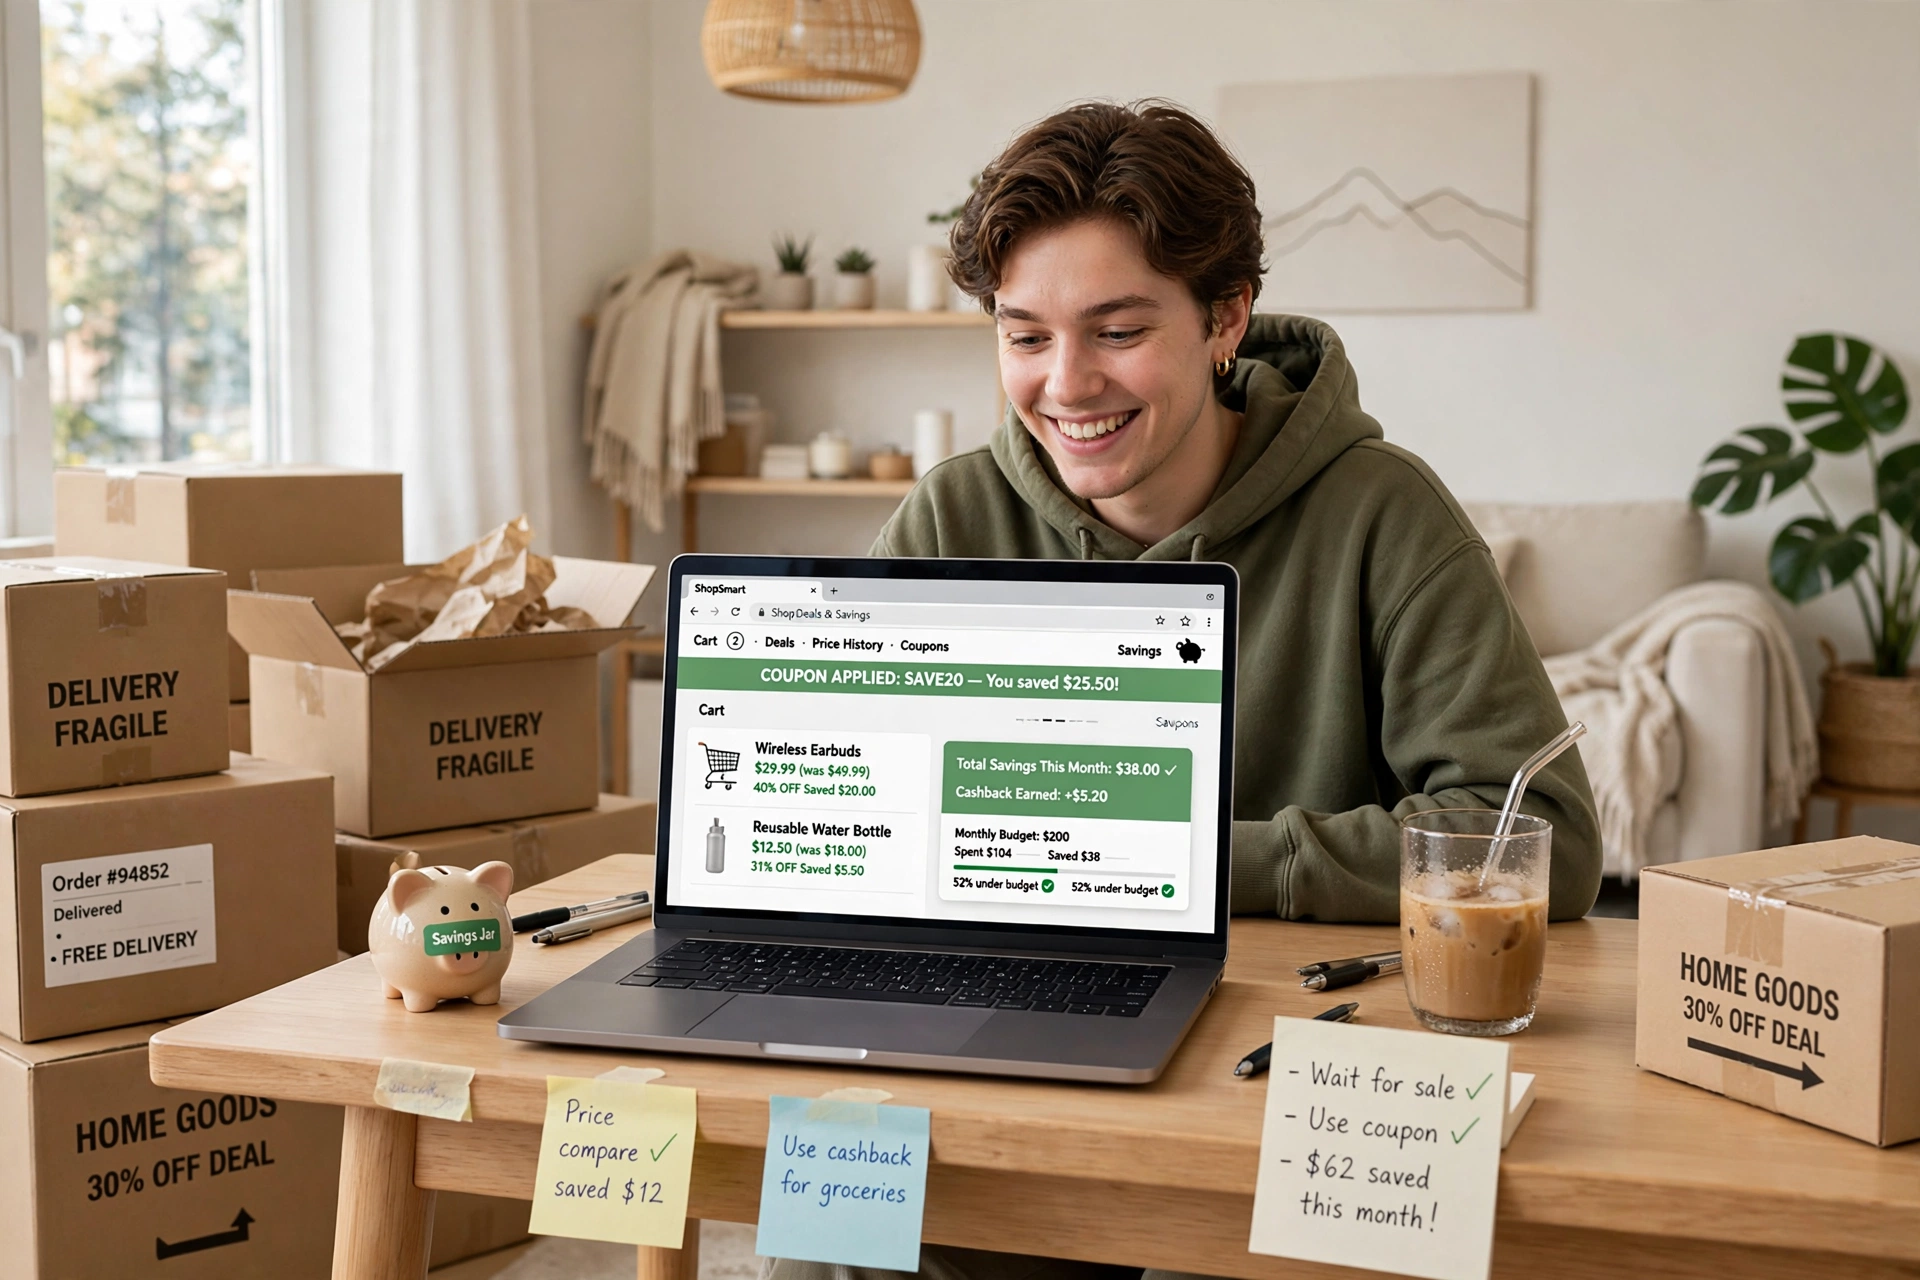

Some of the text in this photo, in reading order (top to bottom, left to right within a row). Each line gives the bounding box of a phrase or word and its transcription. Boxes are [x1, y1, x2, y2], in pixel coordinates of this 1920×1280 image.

[694, 584, 746, 595] ShopSmart
[825, 610, 832, 618] &
[836, 609, 870, 622] Savings
[694, 635, 739, 646] Cart 2
[765, 637, 795, 648] Deals
[812, 638, 883, 652] Price History
[900, 640, 949, 653] Coupons
[1117, 644, 1162, 659] Savings
[761, 668, 827, 683] COUPON
[831, 670, 900, 685] APPLIED:
[904, 671, 964, 687] SAVE20
[986, 673, 1013, 688] You
[1017, 675, 1059, 689] saved
[1063, 676, 1119, 692] $25.50!
[48, 671, 179, 709] DELIVERY
[699, 704, 725, 716] Cart
[55, 710, 168, 747] FRAGILE
[429, 711, 543, 746] DELIVERY
[755, 741, 861, 757] Wireless Earbuds
[437, 748, 534, 781] FRAGILE
[755, 761, 870, 780] $29.99 (was $49.99)
[957, 757, 1160, 776] Total Savings This Month: $38.00
[753, 782, 876, 797] 40% OFF Saved $20.00
[956, 786, 1108, 803] Cashback Earned: +$5.20
[753, 820, 892, 838] Reusable Water Bottle
[955, 828, 1070, 842] Monthly Budget: $200
[752, 840, 866, 859] $12.50 (was $18.00)
[954, 846, 1012, 859] Spent $104
[1048, 850, 1100, 862] Saved $38
[52, 862, 169, 892] Order #94852
[751, 861, 864, 876] 31% OFF Saved $5.50
[953, 877, 1039, 892] 52% under budget
[1072, 882, 1158, 897] 52% under budget
[54, 900, 122, 921] Delivered
[432, 927, 496, 946] Savings Jar
[62, 930, 198, 965] FREE DELIVERY
[1680, 952, 1840, 1021] HOME GOODS
[1683, 995, 1826, 1058] 30% OFF DEAL
[1311, 1061, 1360, 1089] Wait
[1371, 1067, 1403, 1093] for
[1415, 1074, 1455, 1100] sale
[566, 1098, 615, 1126] Price
[76, 1094, 278, 1154] HOME GOODS
[1309, 1106, 1349, 1134] Use
[1362, 1120, 1438, 1149] coupon
[559, 1141, 638, 1168] compare
[783, 1134, 912, 1167] Use cashback
[87, 1140, 275, 1201] 30% OFF DEAL
[1306, 1149, 1355, 1180] $62
[1368, 1165, 1431, 1190] saved
[554, 1177, 664, 1205] saved $12
[781, 1169, 906, 1207] for groceries
[1300, 1191, 1343, 1219] this
